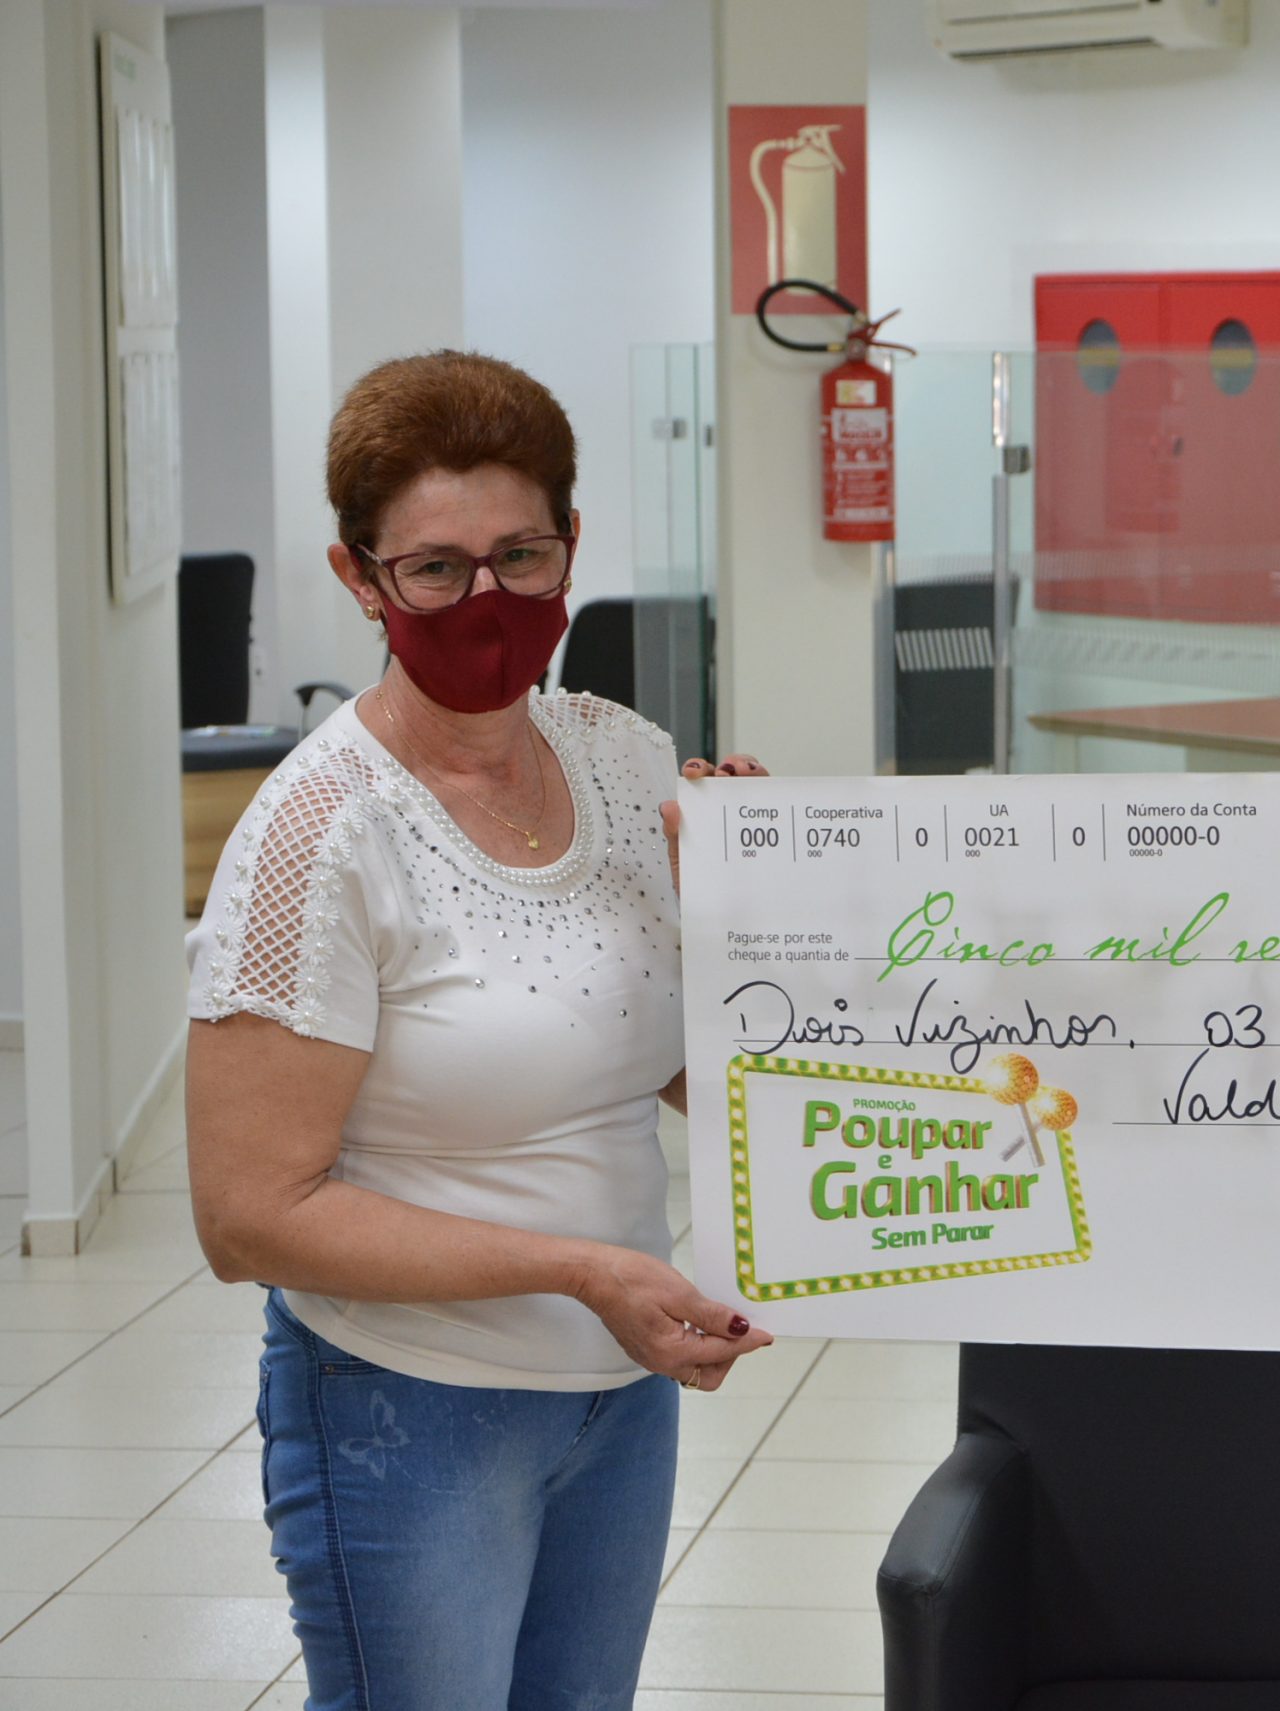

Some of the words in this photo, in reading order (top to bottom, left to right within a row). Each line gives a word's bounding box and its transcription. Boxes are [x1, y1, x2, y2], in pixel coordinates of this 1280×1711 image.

[738, 805, 779, 822] Comp
[804, 805, 884, 822] Cooperativa
[989, 803, 1010, 817] UA
[1126, 801, 1182, 818] Número
[1185, 802, 1209, 817] da
[1212, 802, 1258, 817] Conta
[739, 827, 780, 848] 000
[806, 827, 861, 848] 0740
[914, 827, 930, 848] 0
[964, 826, 1020, 848] 0021
[1071, 826, 1087, 847] 0
[1126, 825, 1221, 847] 00000-0
[1128, 848, 1164, 857] 00000-0
[727, 930, 780, 947] Pague-se
[783, 933, 806, 947] por
[807, 932, 833, 945] este
[876, 891, 1056, 982] Cinco
[1084, 892, 1230, 968] mil
[727, 947, 772, 963] cheque
[774, 951, 782, 962] a
[785, 948, 830, 963] quantia
[833, 947, 850, 962] de
[1203, 1004, 1266, 1048] 03
[852, 1098, 917, 1112] PROMOÇÃO
[802, 1100, 993, 1160] Poupar
[877, 1155, 893, 1170] e
[809, 1160, 1040, 1221] Ganhar
[871, 1226, 927, 1250] Sem
[931, 1222, 995, 1245] Parar
